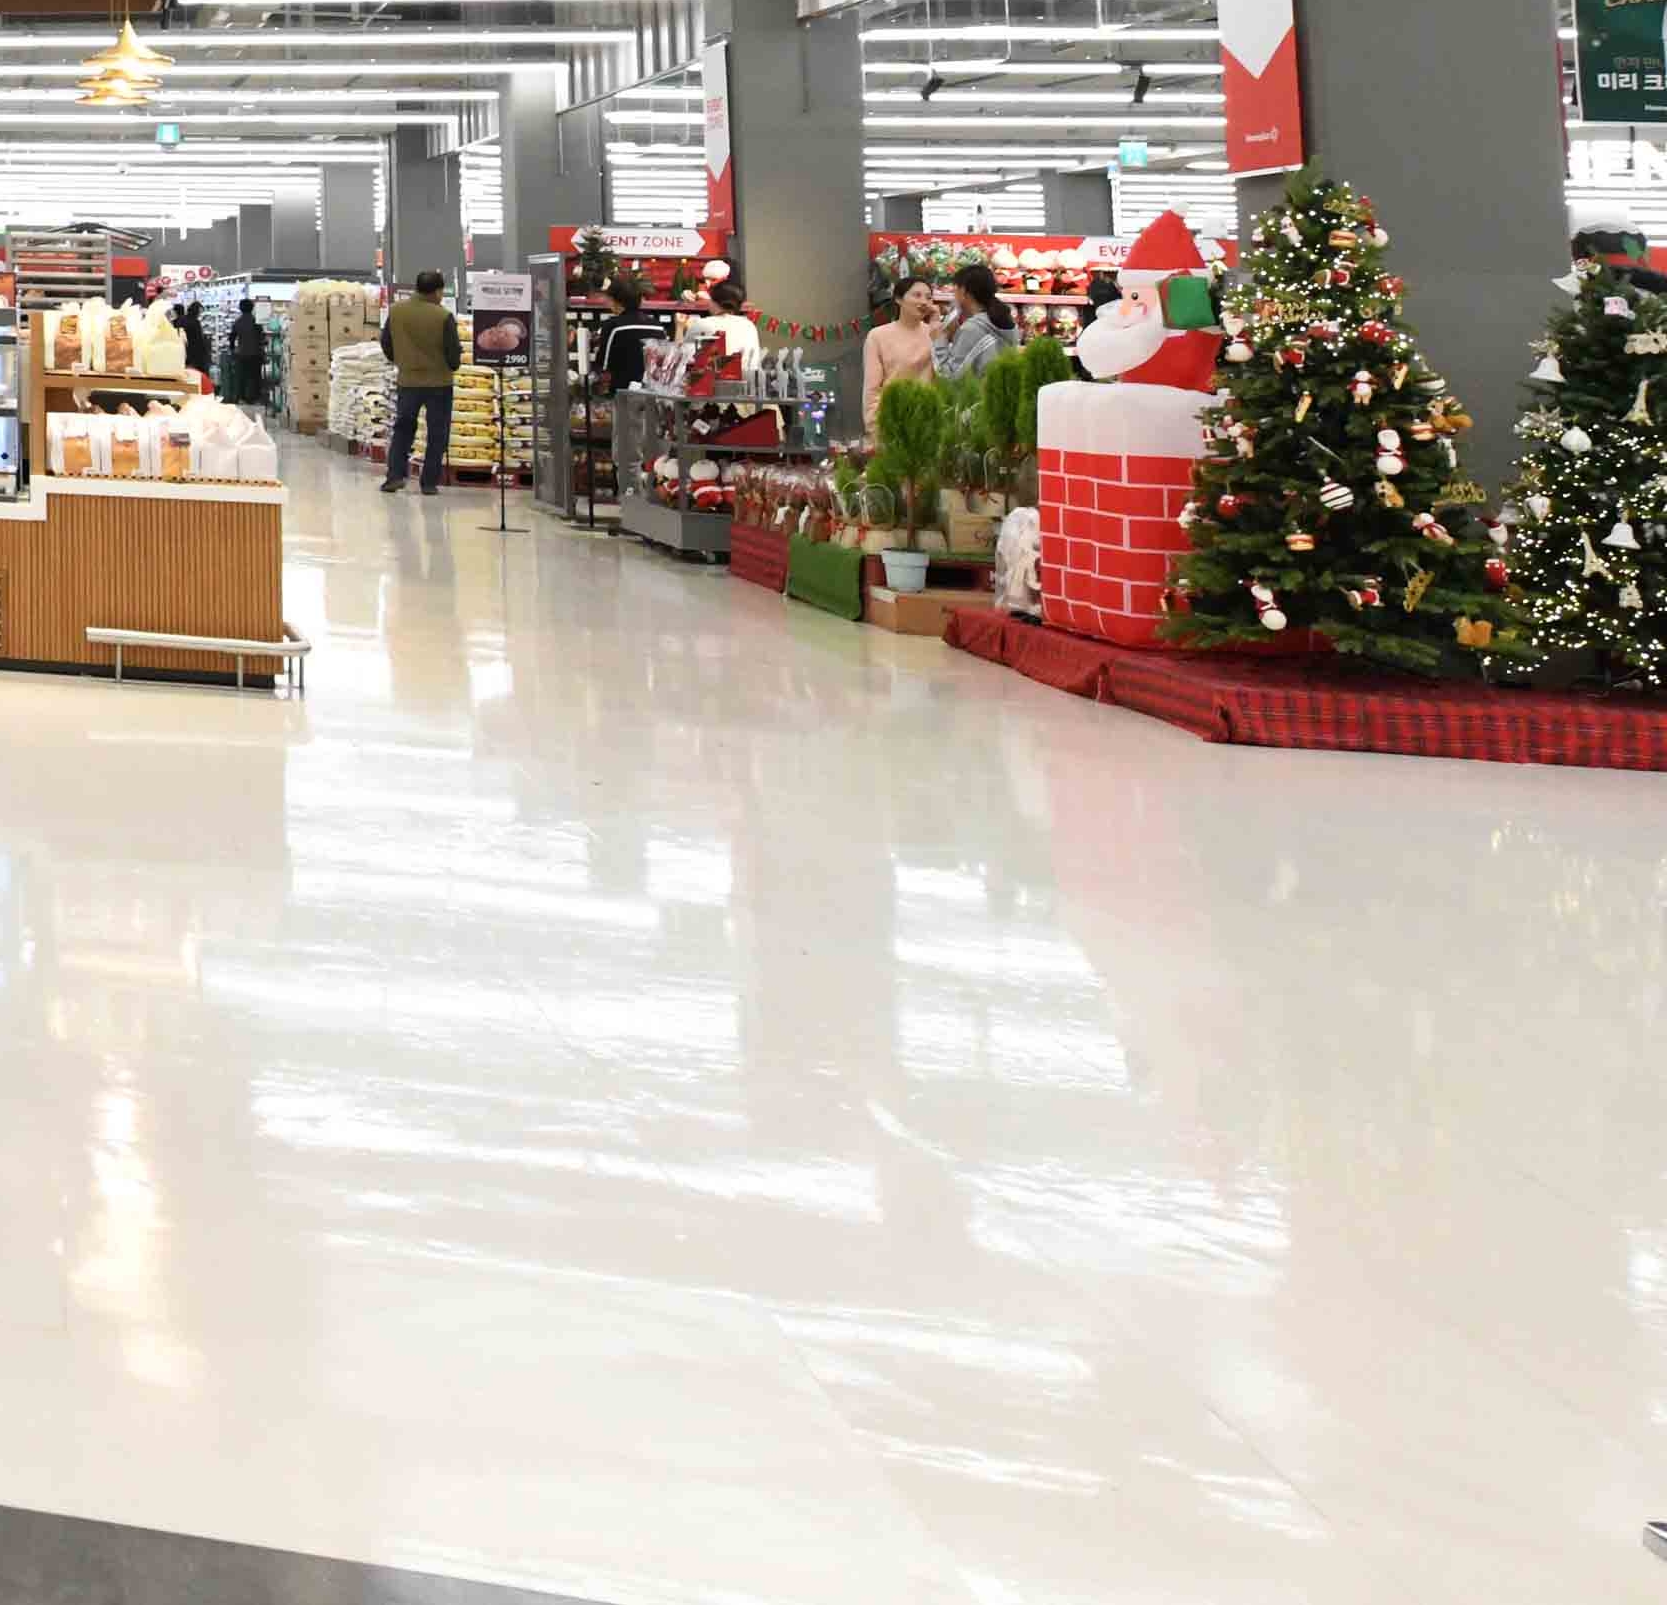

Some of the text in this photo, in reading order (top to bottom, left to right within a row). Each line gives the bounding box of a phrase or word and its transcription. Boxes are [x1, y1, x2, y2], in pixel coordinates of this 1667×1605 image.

[1597, 73, 1667, 91] 미리 크
[643, 236, 683, 248] ZONE
[1099, 246, 1130, 257] EVE
